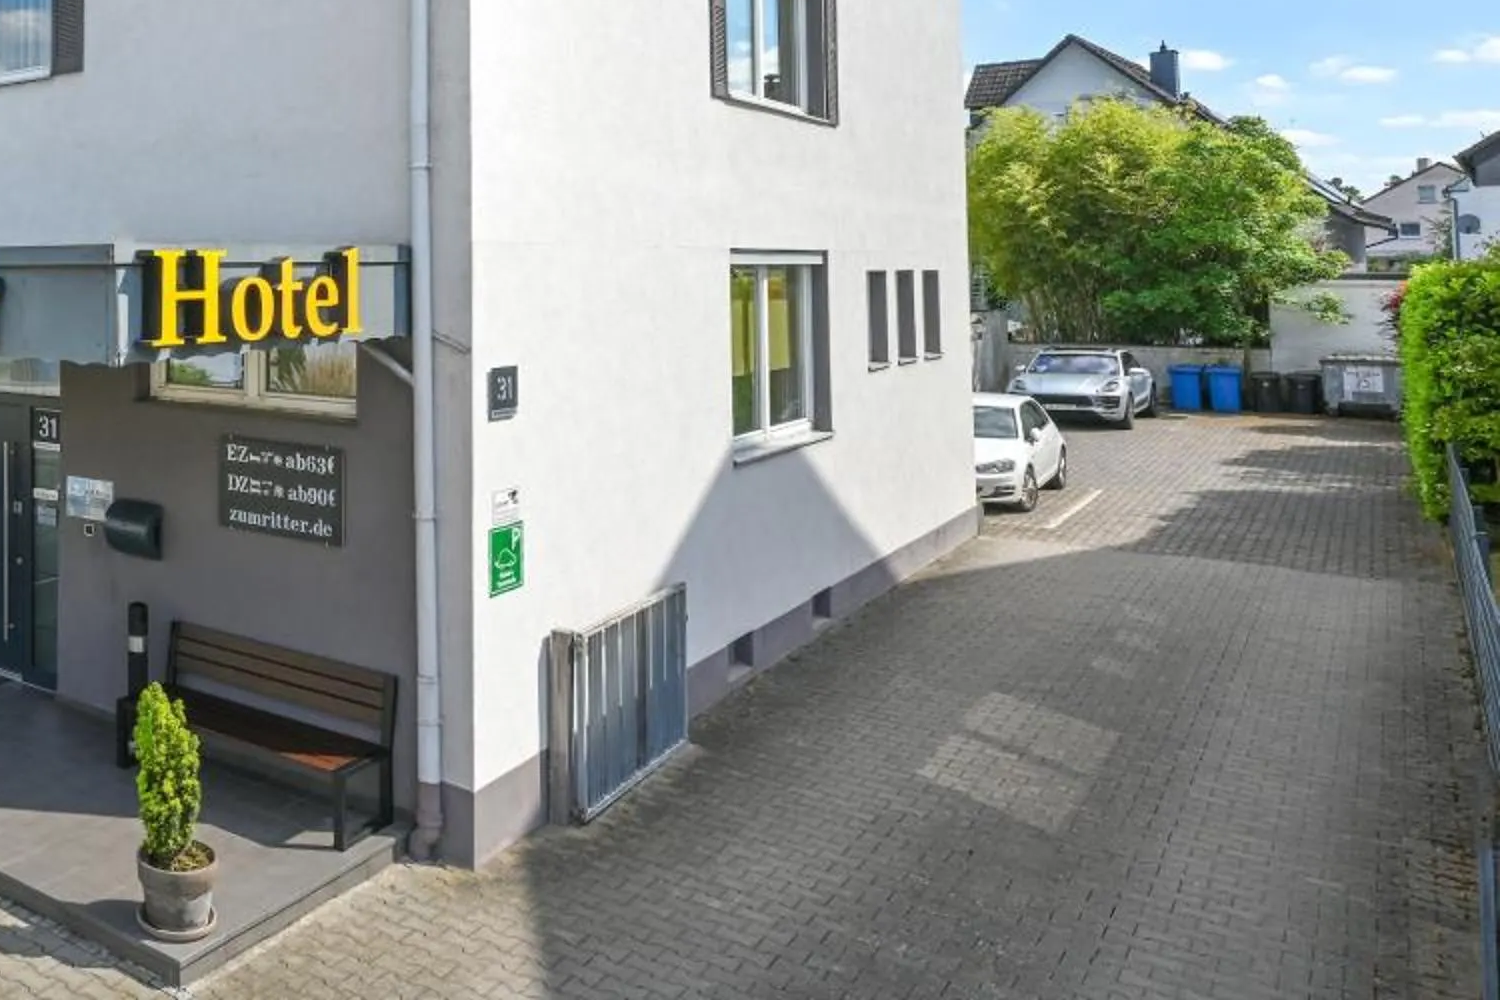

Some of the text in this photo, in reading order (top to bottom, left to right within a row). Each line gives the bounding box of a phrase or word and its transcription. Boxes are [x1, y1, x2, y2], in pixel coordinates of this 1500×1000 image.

[153, 247, 361, 348] Hotel
[496, 376, 513, 401] 31
[39, 415, 58, 439] 31
[229, 508, 333, 537] zumritter.de
